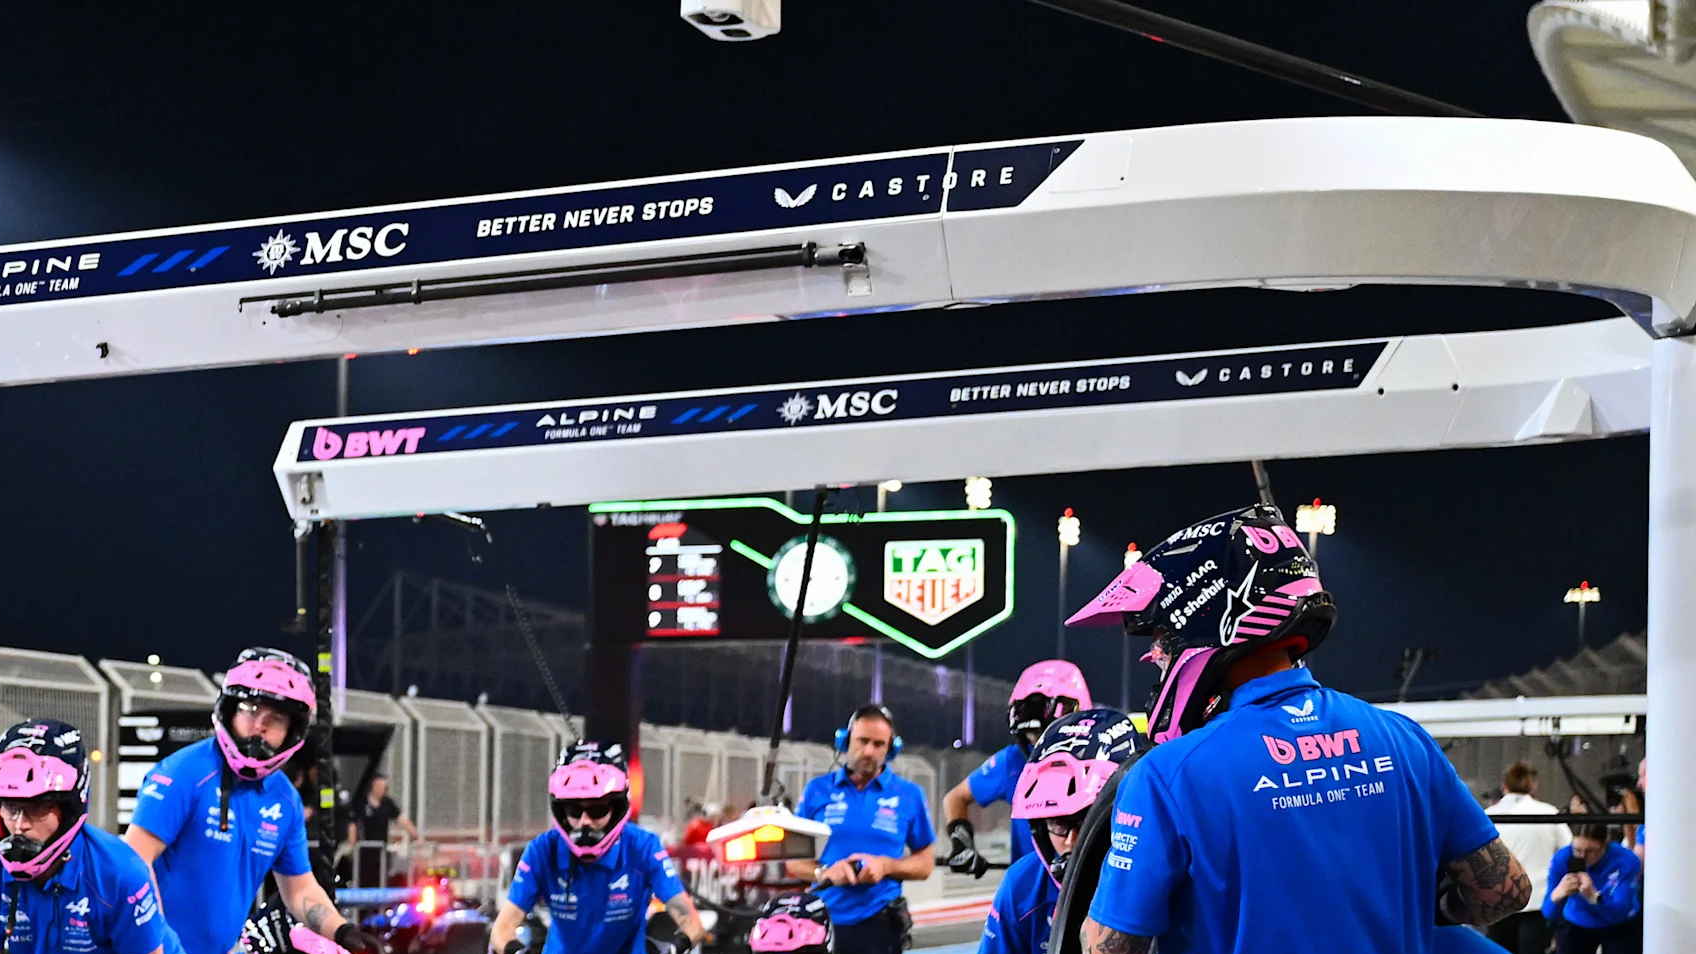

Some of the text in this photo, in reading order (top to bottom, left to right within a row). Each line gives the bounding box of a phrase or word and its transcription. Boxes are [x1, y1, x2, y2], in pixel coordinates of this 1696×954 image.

[831, 166, 1014, 201] CASTORE
[476, 197, 714, 238] BETTER NEVER STOPS
[300, 222, 409, 265] MSC
[48, 277, 80, 293] TEAM
[1218, 357, 1354, 383] CASTORE
[813, 388, 899, 420] MSC
[950, 375, 1131, 403] BETTER NEVER STOPS
[535, 405, 658, 428] ALPINE
[544, 426, 587, 440] FORMULA
[616, 422, 642, 435] TEAM
[343, 427, 426, 459] BWT
[1181, 521, 1226, 541] MSC
[893, 547, 975, 573] TAG
[891, 578, 976, 617] HEUER
[1183, 577, 1227, 617] shamir
[1296, 728, 1361, 761] BWT
[1253, 756, 1395, 792] ALPINE
[1272, 792, 1324, 810] FORMULA
[1354, 781, 1385, 797] TEAM
